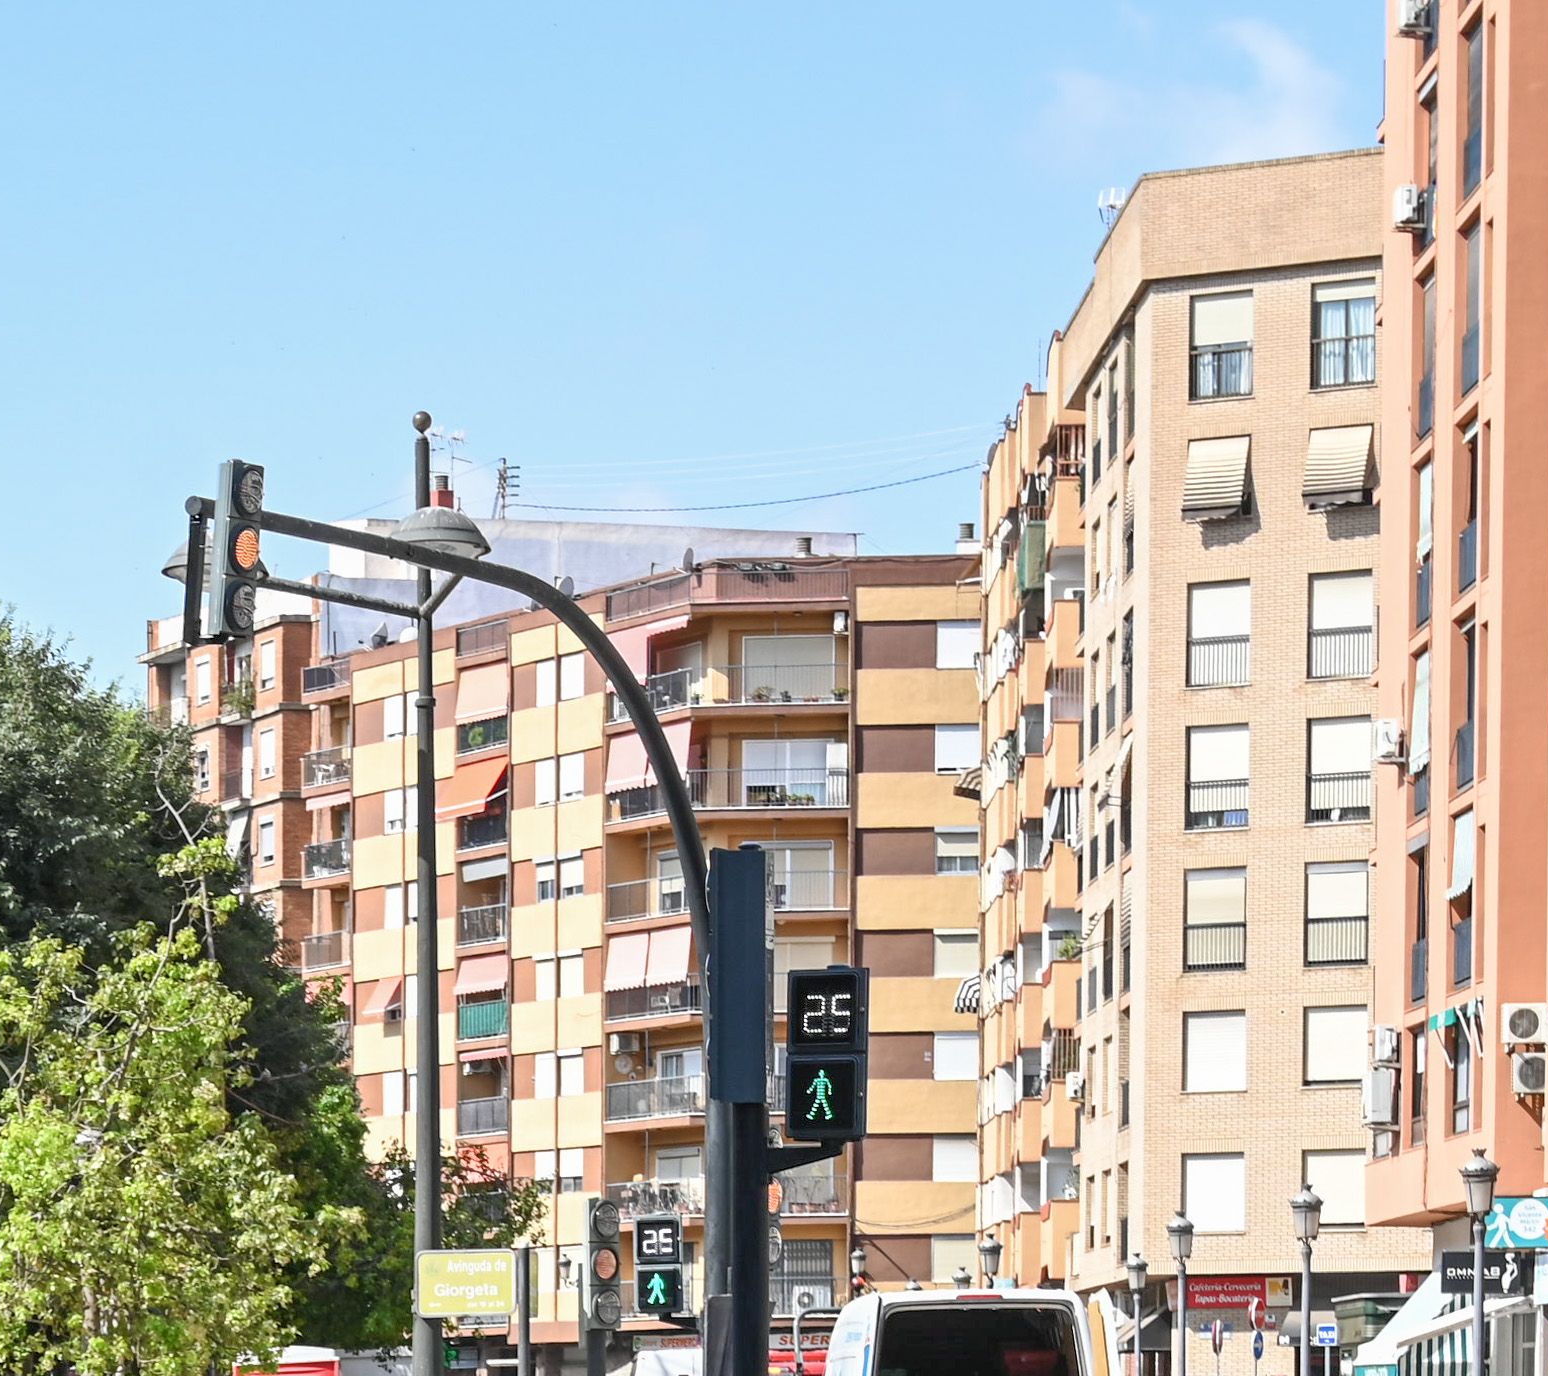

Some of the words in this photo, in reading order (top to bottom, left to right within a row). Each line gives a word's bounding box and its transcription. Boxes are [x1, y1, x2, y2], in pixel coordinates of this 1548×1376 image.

[803, 994, 851, 1033] 25
[643, 1228, 673, 1254] 25
[447, 1259, 492, 1275] Avinguda
[496, 1258, 507, 1272] de
[434, 1283, 499, 1299] Giorgeta
